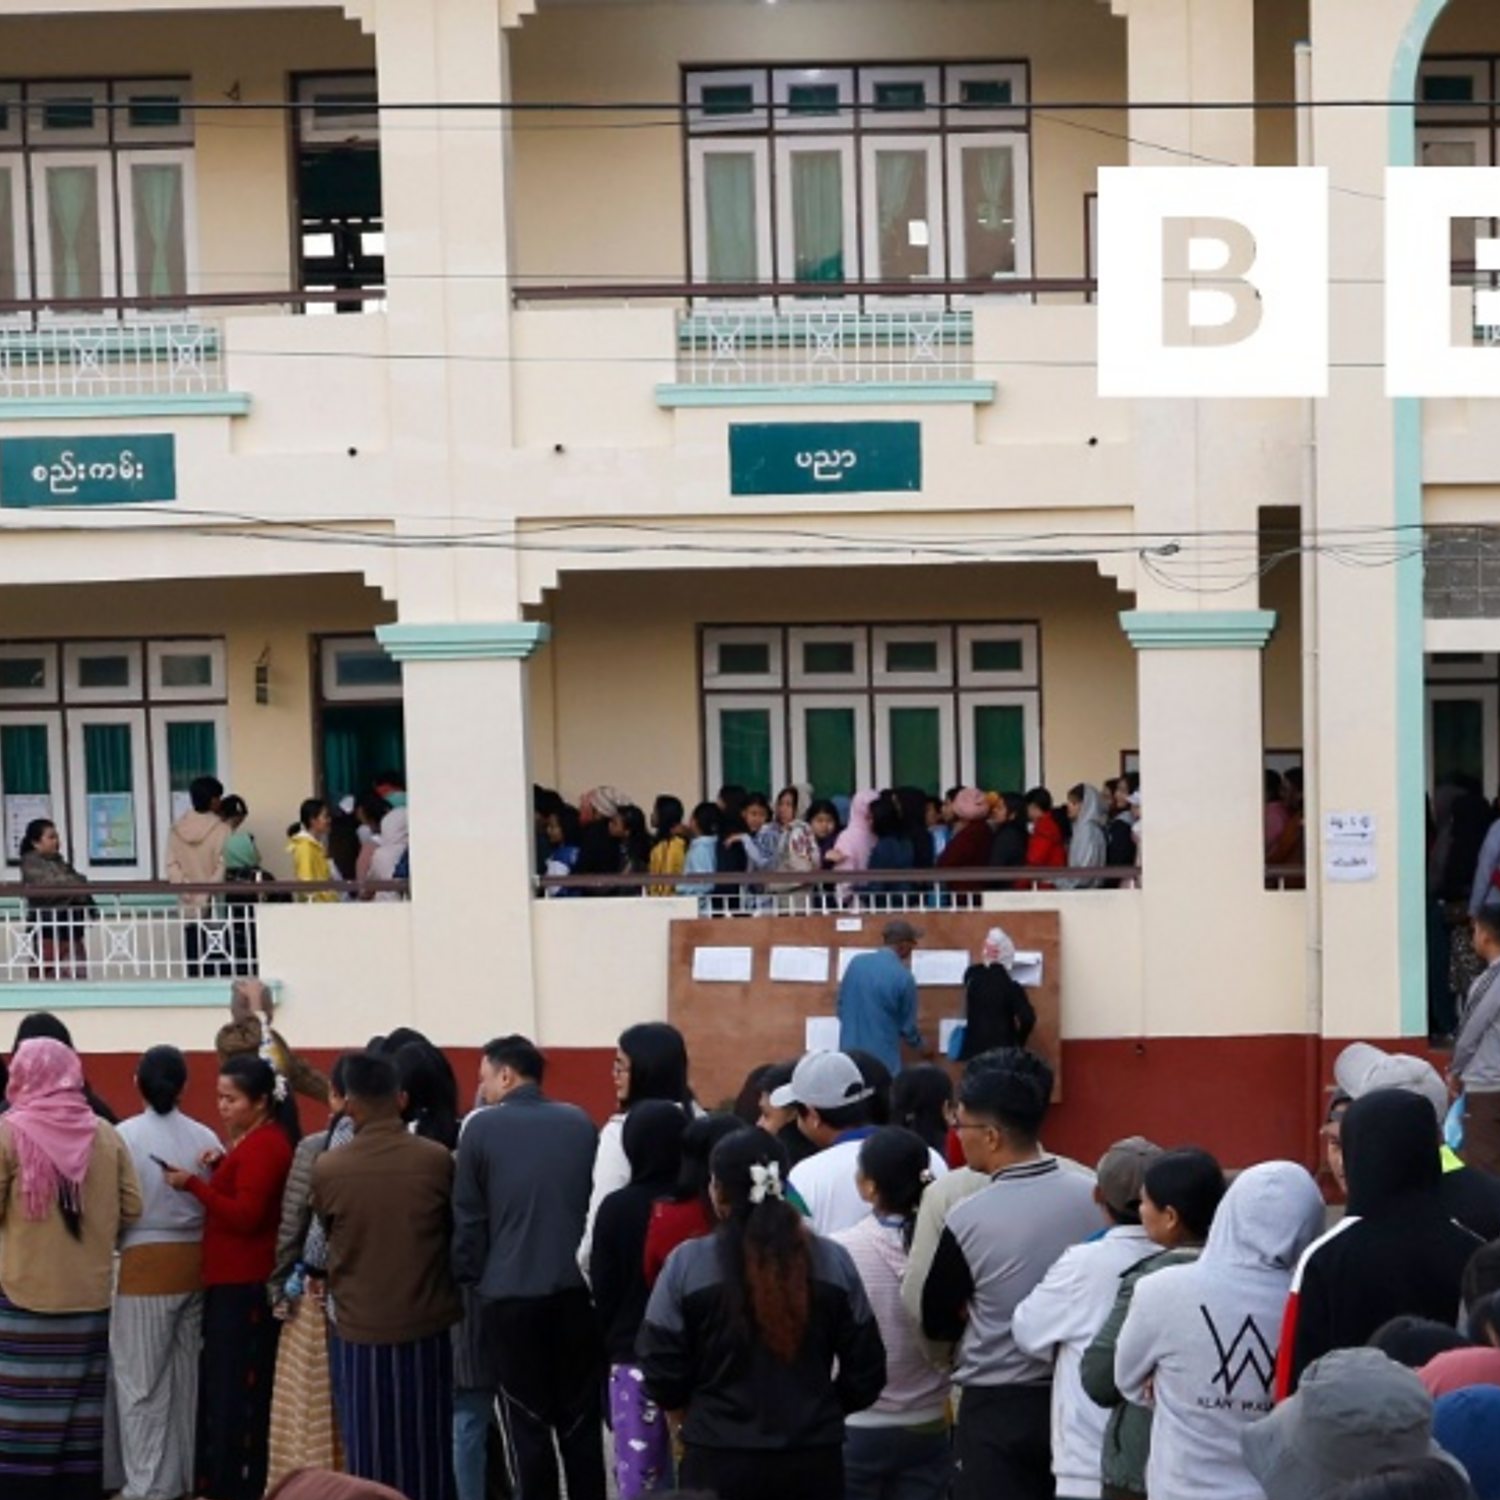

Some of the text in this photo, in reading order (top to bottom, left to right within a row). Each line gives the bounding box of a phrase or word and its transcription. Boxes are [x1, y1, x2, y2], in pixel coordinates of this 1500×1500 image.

[31, 450, 145, 493] စည်းကမ်း
[795, 449, 857, 481] ပညာ
